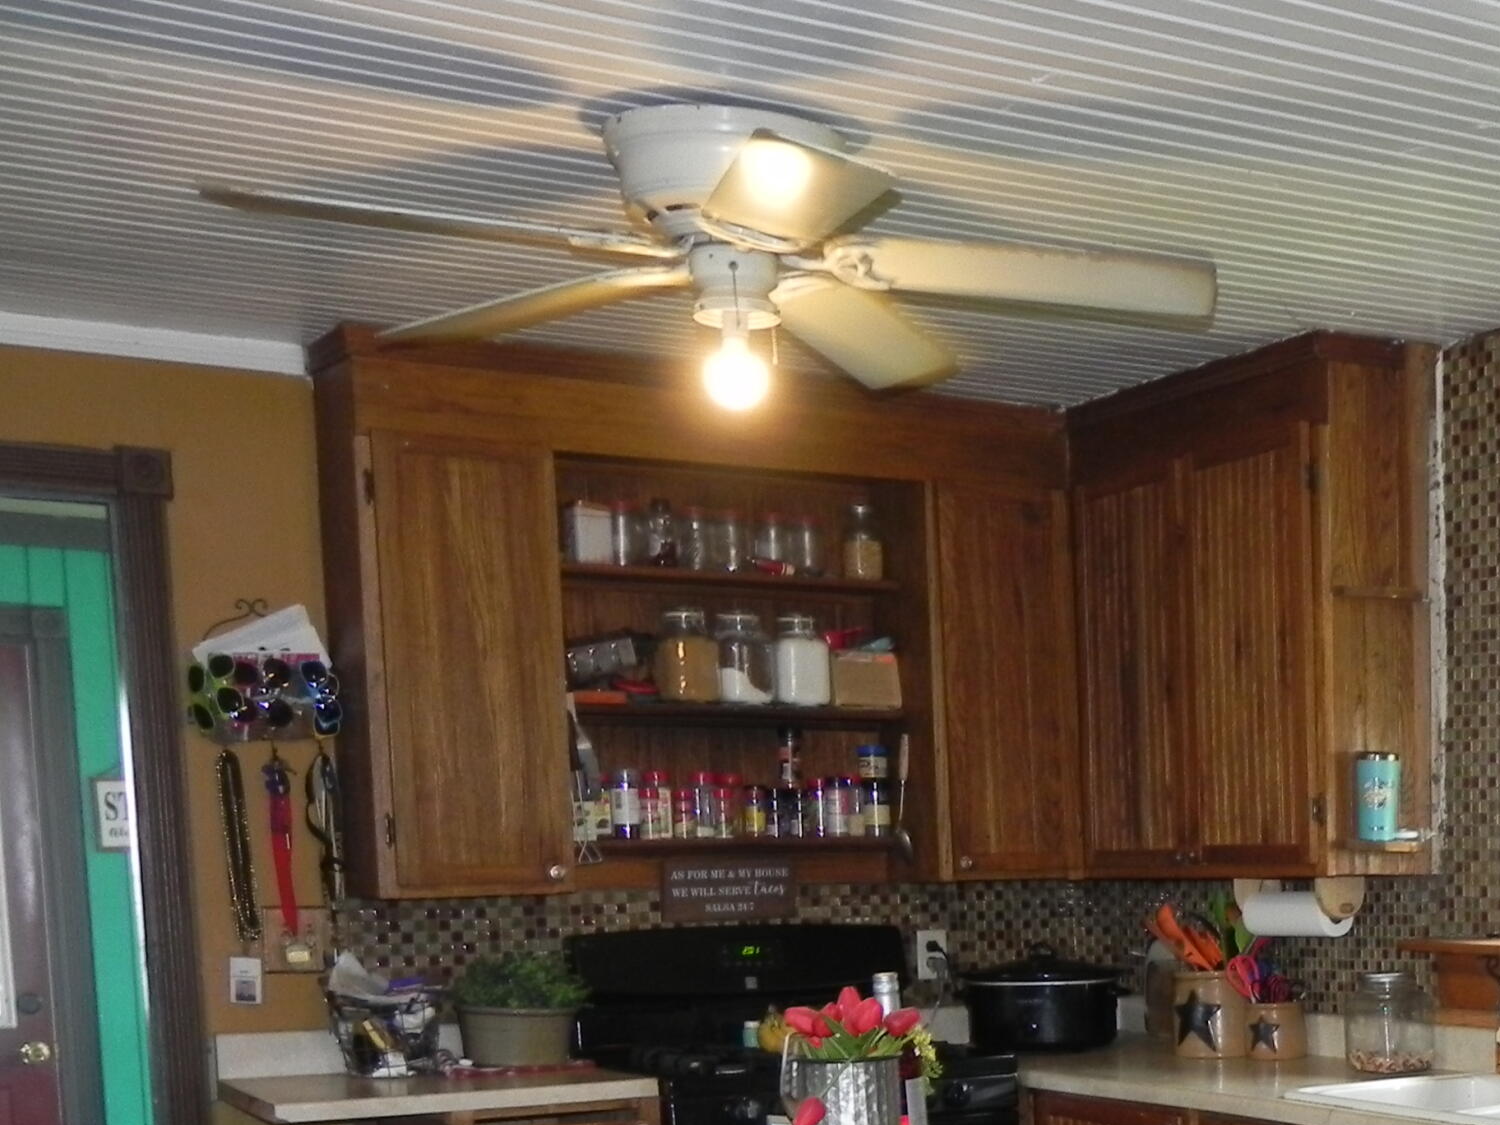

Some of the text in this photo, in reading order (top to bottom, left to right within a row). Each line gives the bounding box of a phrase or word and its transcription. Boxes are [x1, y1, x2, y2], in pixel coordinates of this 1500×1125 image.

[671, 871, 685, 880] AS
[687, 870, 708, 880] FOR
[710, 869, 725, 879] ME
[739, 869, 751, 878] MY
[754, 868, 788, 878] HOUSE
[672, 888, 688, 898] WE
[691, 887, 716, 897] WILL
[718, 886, 751, 896] SERVE
